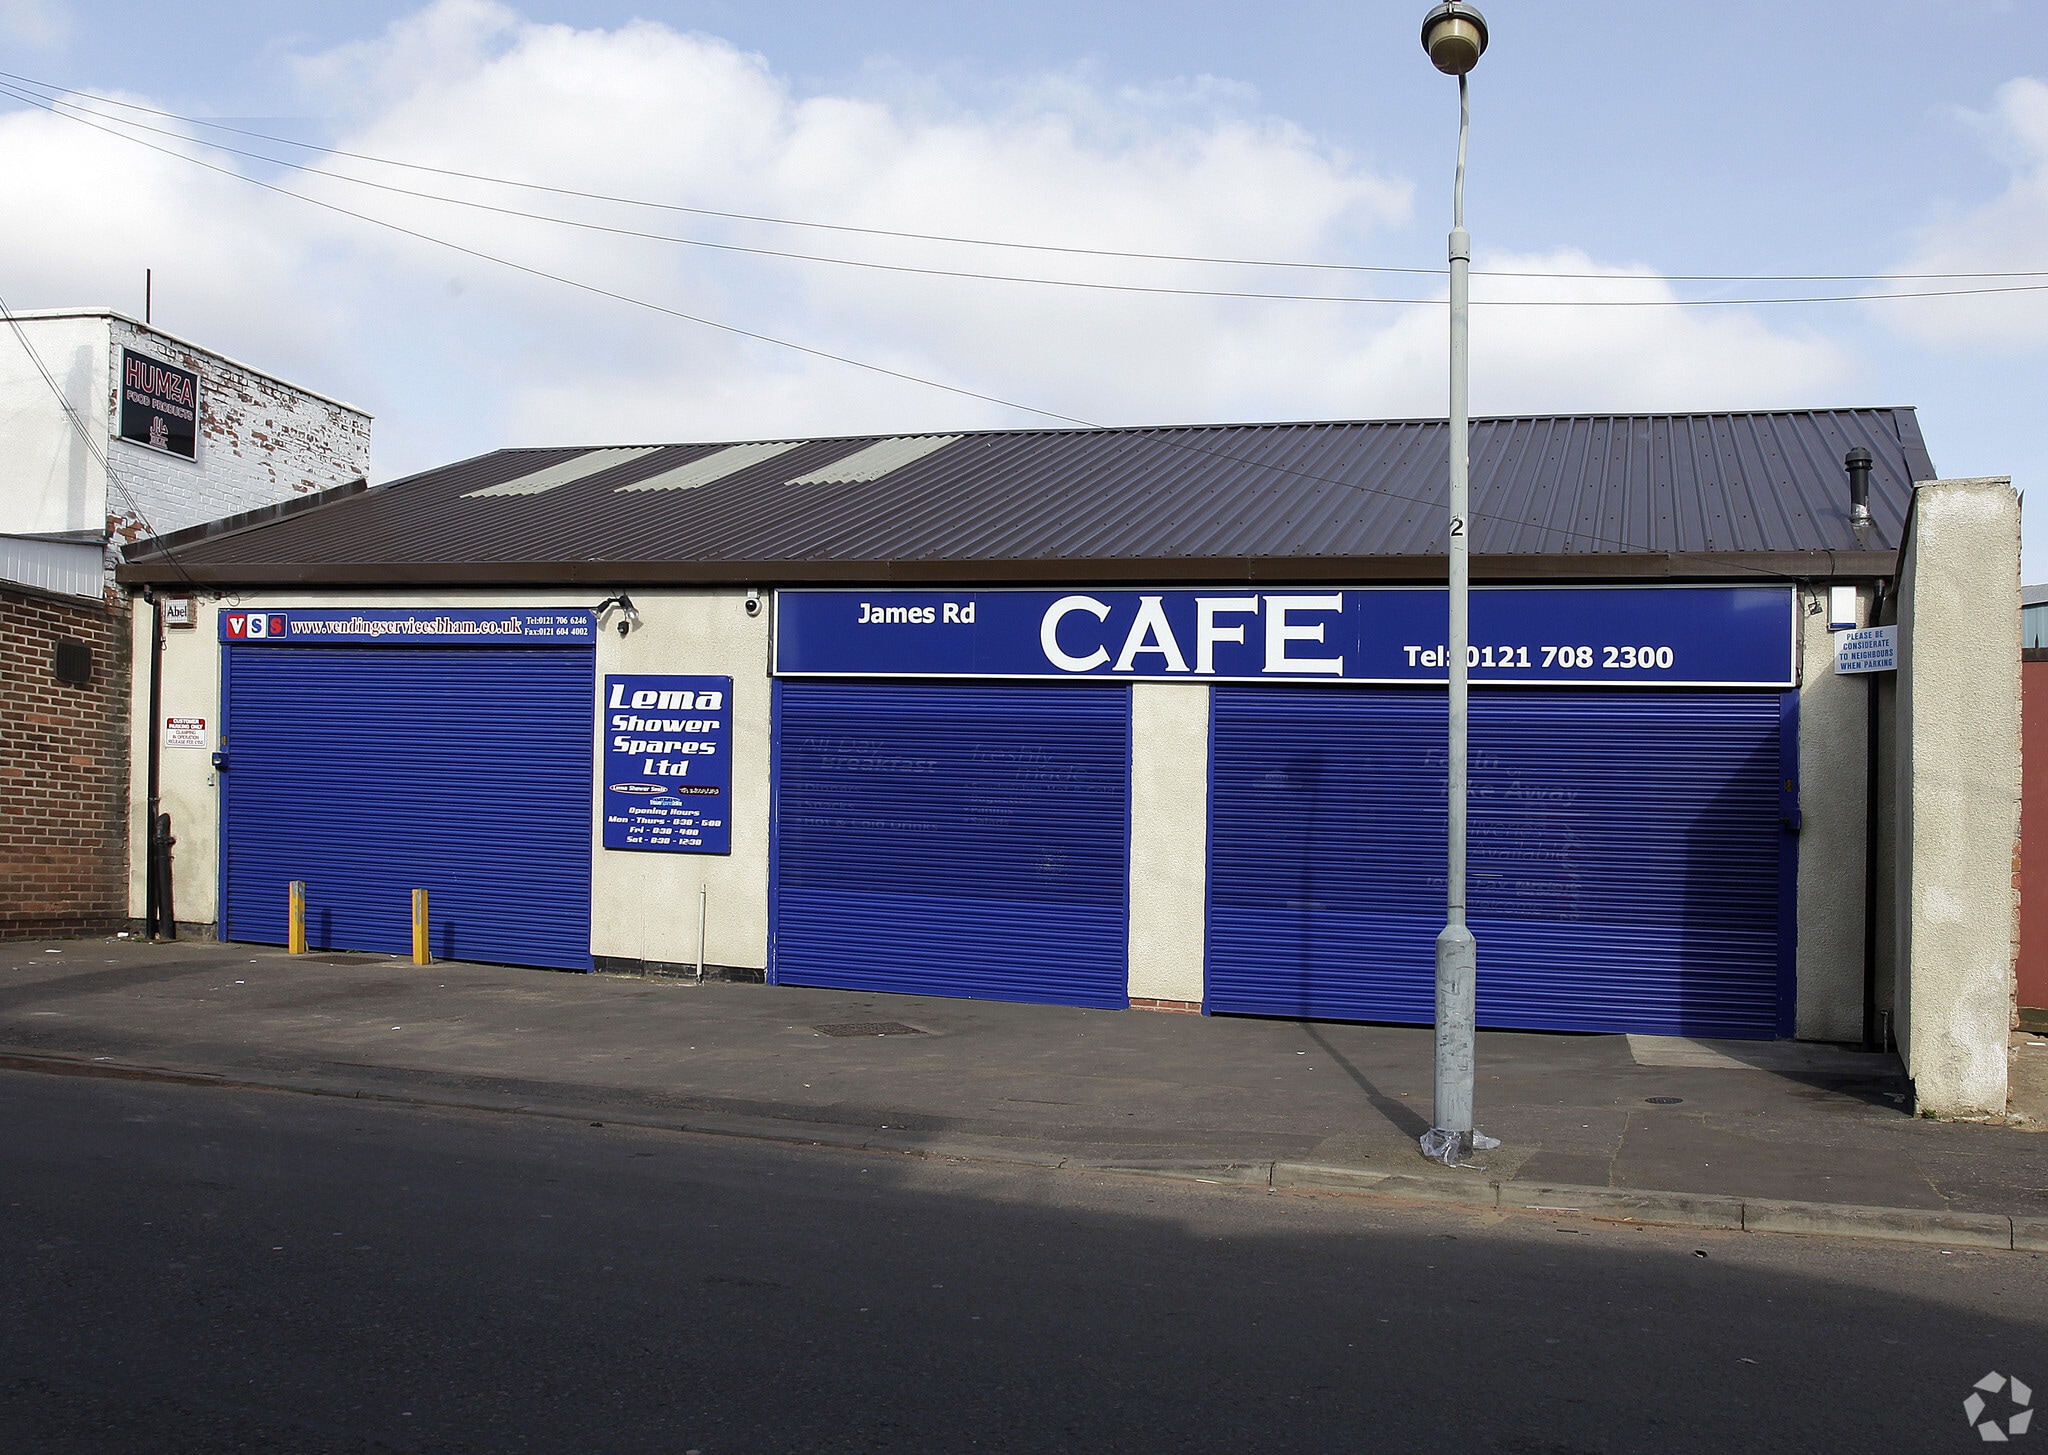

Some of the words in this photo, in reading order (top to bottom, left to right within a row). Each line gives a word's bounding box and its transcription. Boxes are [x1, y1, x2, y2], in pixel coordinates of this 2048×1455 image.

[126, 357, 194, 408] HUMZA
[126, 389, 151, 407] FOOD
[151, 398, 194, 421] PRODUCTS
[167, 606, 187, 617] Abel
[857, 602, 936, 625] James
[942, 602, 976, 624] Rd
[291, 617, 522, 637] www.vendingservicesbham.co.uk
[556, 616, 568, 625] 706
[570, 616, 587, 625] 6246
[556, 627, 569, 636] 604
[571, 627, 588, 636] 4002
[1040, 593, 1344, 674] CAFE
[1846, 631, 1873, 641] PLEASE
[1874, 630, 1884, 638] BE
[1843, 639, 1890, 651] CONSIDERATE
[1541, 647, 1594, 668] 708
[1602, 647, 1674, 668] 2300
[1840, 653, 1849, 661] TO
[1851, 648, 1894, 661] NEIGHBOURS
[1840, 662, 1862, 671] WHEN
[1864, 658, 1893, 669] PARKING
[609, 684, 723, 711] Lema
[611, 715, 720, 733] Shower
[612, 736, 717, 755] Spares
[643, 759, 690, 776] Ltd
[628, 807, 668, 816] Opening
[636, 817, 665, 825] Thurs
